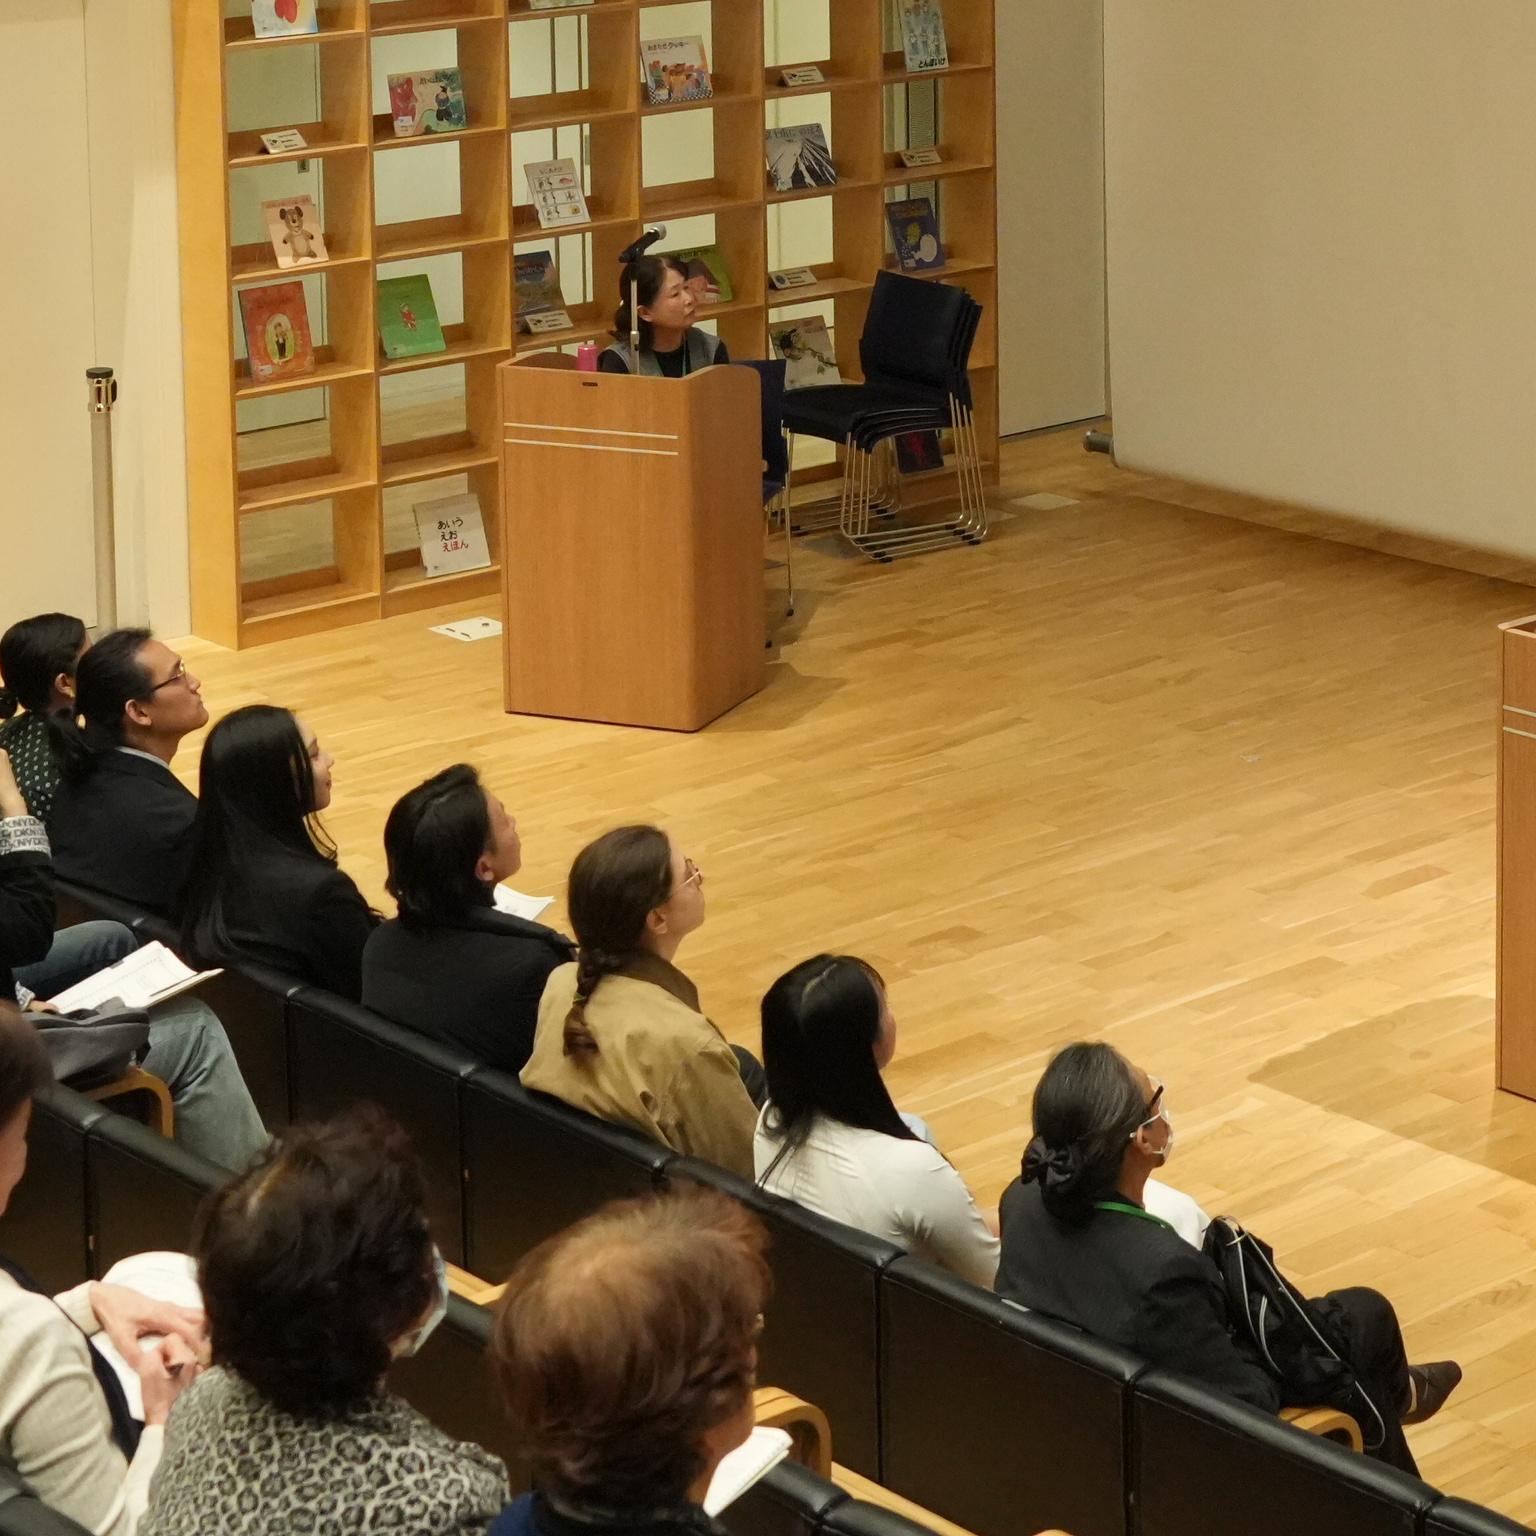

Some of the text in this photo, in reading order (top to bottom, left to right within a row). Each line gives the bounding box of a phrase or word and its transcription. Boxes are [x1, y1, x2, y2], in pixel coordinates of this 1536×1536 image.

[437, 517, 463, 529] あいう
[441, 531, 458, 541] えお
[443, 541, 468, 552] えほん
